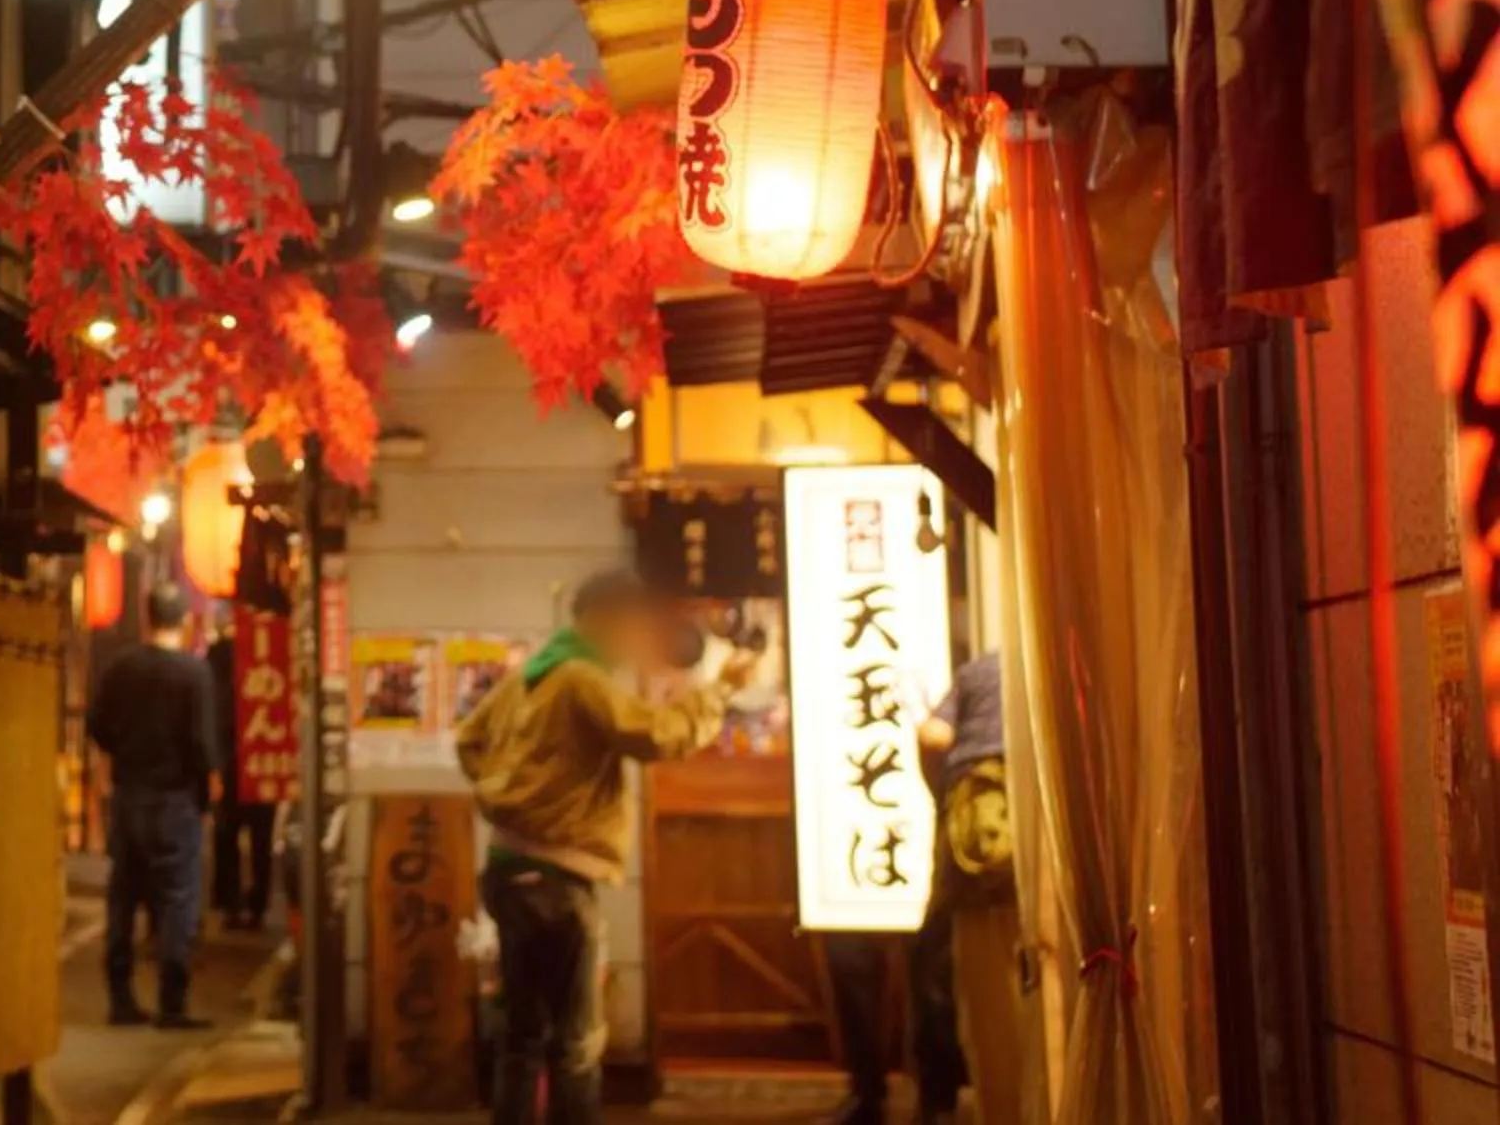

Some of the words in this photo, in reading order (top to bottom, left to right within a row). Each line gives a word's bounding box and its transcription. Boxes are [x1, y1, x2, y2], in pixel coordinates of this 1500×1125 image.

[241, 615, 287, 746] ーめん
[840, 584, 908, 887] 天玉そば
